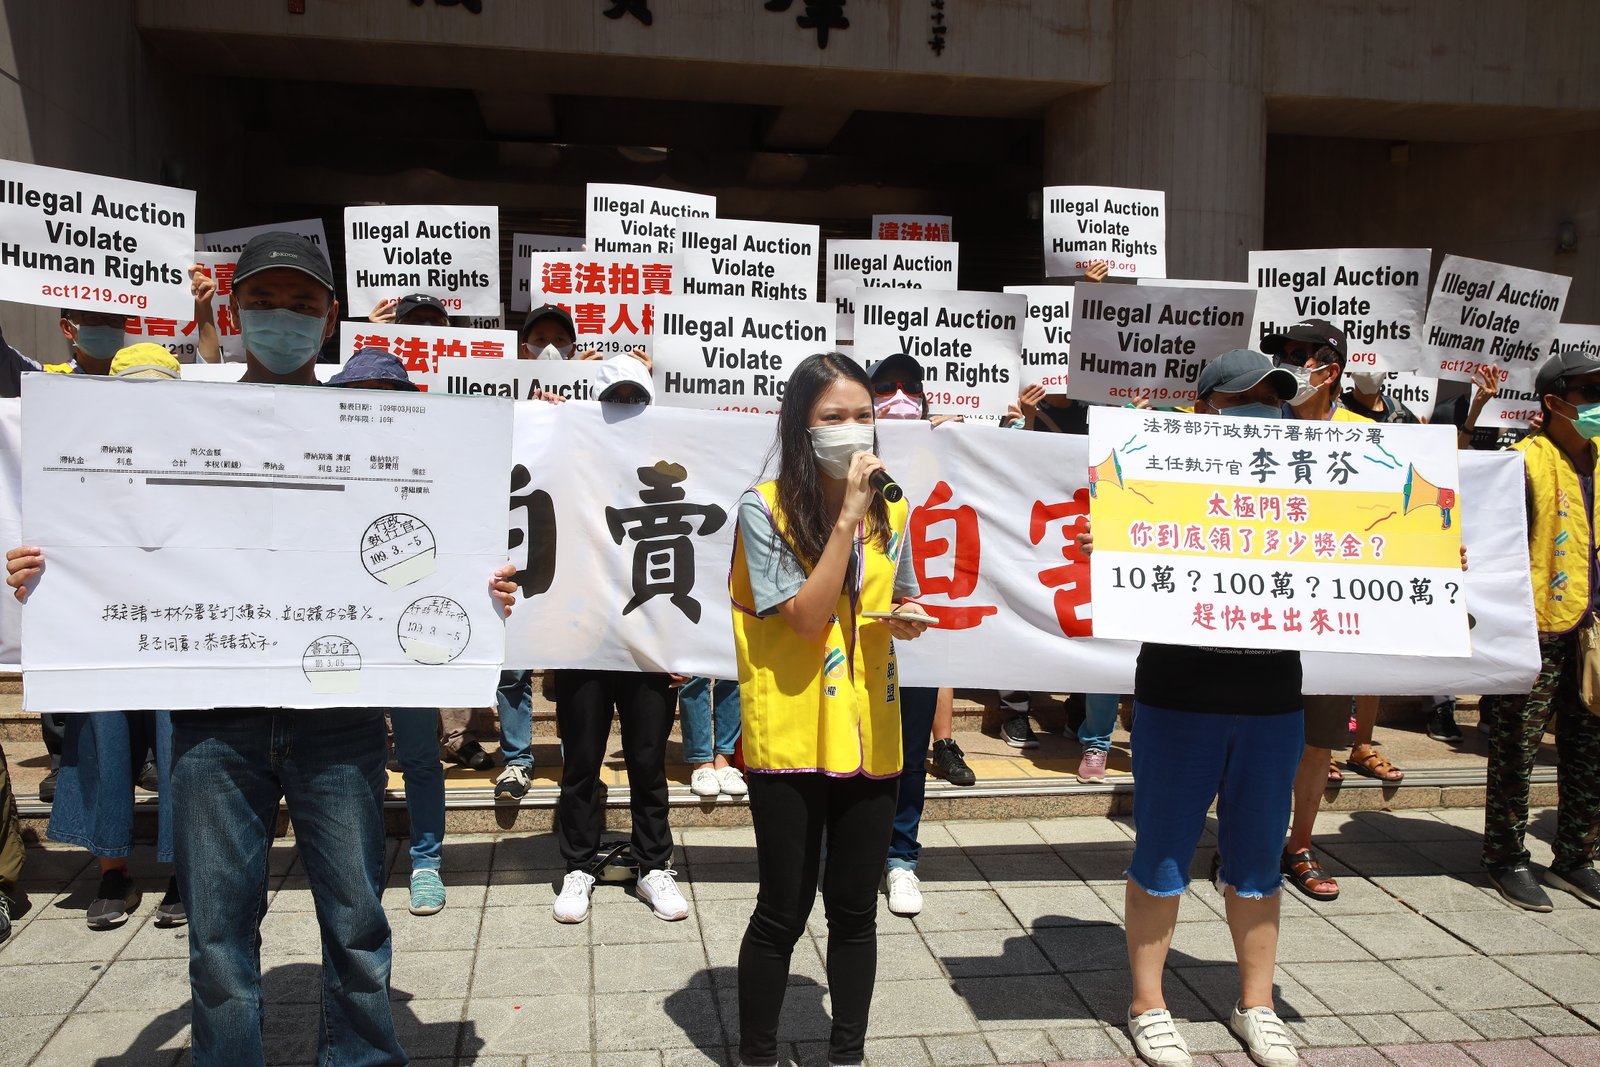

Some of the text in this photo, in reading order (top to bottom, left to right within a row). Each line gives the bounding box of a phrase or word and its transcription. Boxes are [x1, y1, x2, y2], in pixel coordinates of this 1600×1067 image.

[0, 180, 185, 229] Illegal Auction
[593, 197, 710, 219] Illegal Auction
[1050, 198, 1160, 218] Illegal Auction
[45, 220, 138, 253] Violate
[352, 220, 491, 243] Illegal Auction
[1077, 219, 1130, 236] Violate
[383, 247, 452, 265] Violate
[594, 238, 652, 253] Human
[681, 231, 738, 254] Illegal
[742, 234, 812, 256] Auction
[1052, 237, 1158, 258] Human Rights
[2, 243, 95, 276] Human
[104, 255, 183, 287] Rights
[712, 257, 775, 278] Violate
[833, 253, 952, 274] Illegal Auction
[356, 269, 490, 291] Human Rights
[541, 262, 673, 295] 違法拍賣
[683, 277, 807, 301] Human Rights
[1257, 265, 1419, 292] Illegal Auction
[42, 284, 148, 309] act1219.org
[1441, 272, 1560, 312] Illegal Auction
[863, 304, 929, 331] Illegal
[935, 307, 1016, 330] Auction
[1081, 299, 1245, 328] Illegal Auction
[1293, 295, 1371, 316] Violate
[663, 313, 827, 342] Illegal Auction
[1343, 319, 1411, 345] Rights
[1460, 305, 1520, 334] Violate
[899, 335, 972, 358] Violate
[1117, 331, 1196, 355] Violate
[1428, 325, 1540, 363] Human Rights
[701, 346, 783, 371] Violate
[1080, 352, 1157, 378] Human
[664, 371, 745, 396] Human
[945, 361, 1010, 388] Rights
[1144, 418, 1384, 444] 法務部行政執行署新竹分署
[116, 457, 133, 466] 利息
[171, 459, 187, 467] 合計
[1145, 447, 1359, 485] 主任執行官 李貴芬
[1209, 493, 1306, 522] 太極門案
[1192, 602, 1360, 635] 趕快吐出來!!!
